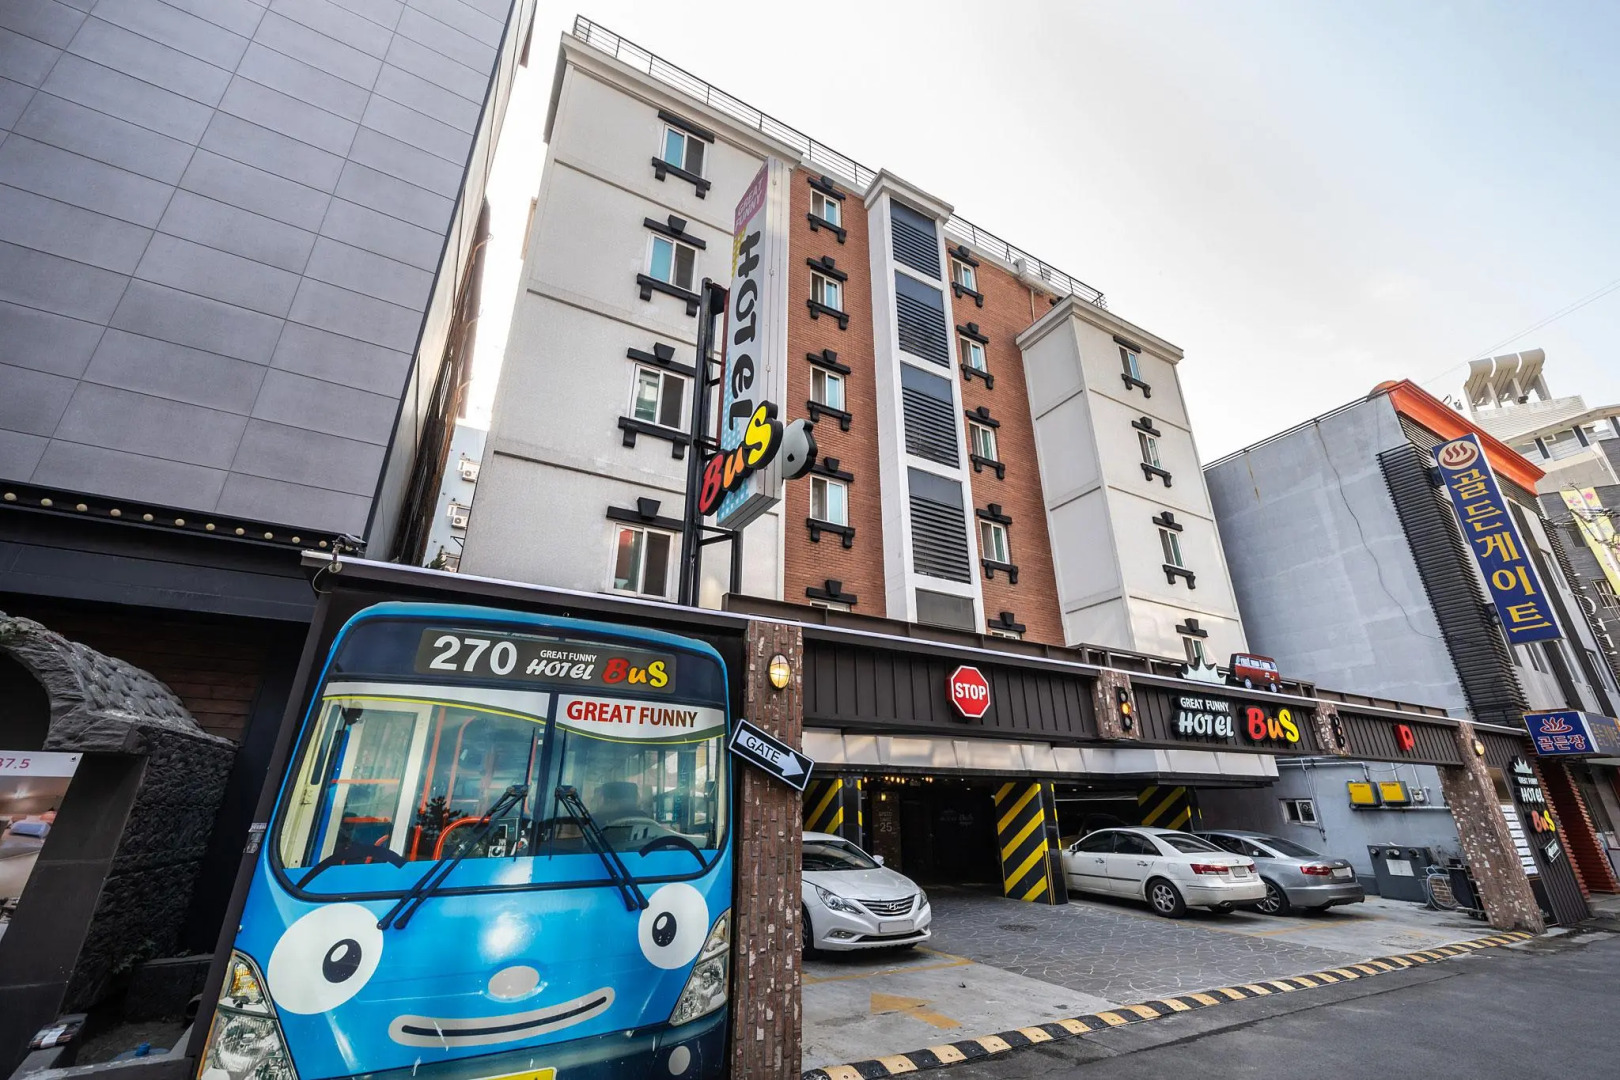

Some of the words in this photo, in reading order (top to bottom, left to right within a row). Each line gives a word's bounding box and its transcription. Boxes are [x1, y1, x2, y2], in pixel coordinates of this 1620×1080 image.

[737, 177, 763, 216] GREAT
[735, 191, 762, 232] FUNNY
[1450, 467, 1553, 634] 골든게이트
[429, 634, 518, 676] 270
[540, 649, 568, 660] GREAT
[568, 651, 598, 663] FUNNY
[954, 682, 987, 701] STOP
[1180, 697, 1203, 710] GREAT
[1205, 699, 1230, 713] FUNNY
[566, 700, 637, 725] GREAT
[638, 706, 699, 729] FUNNY
[745, 736, 781, 764] GATE
[1397, 723, 1415, 752] P
[1537, 734, 1586, 752] 골든장
[879, 821, 893, 833] 25
